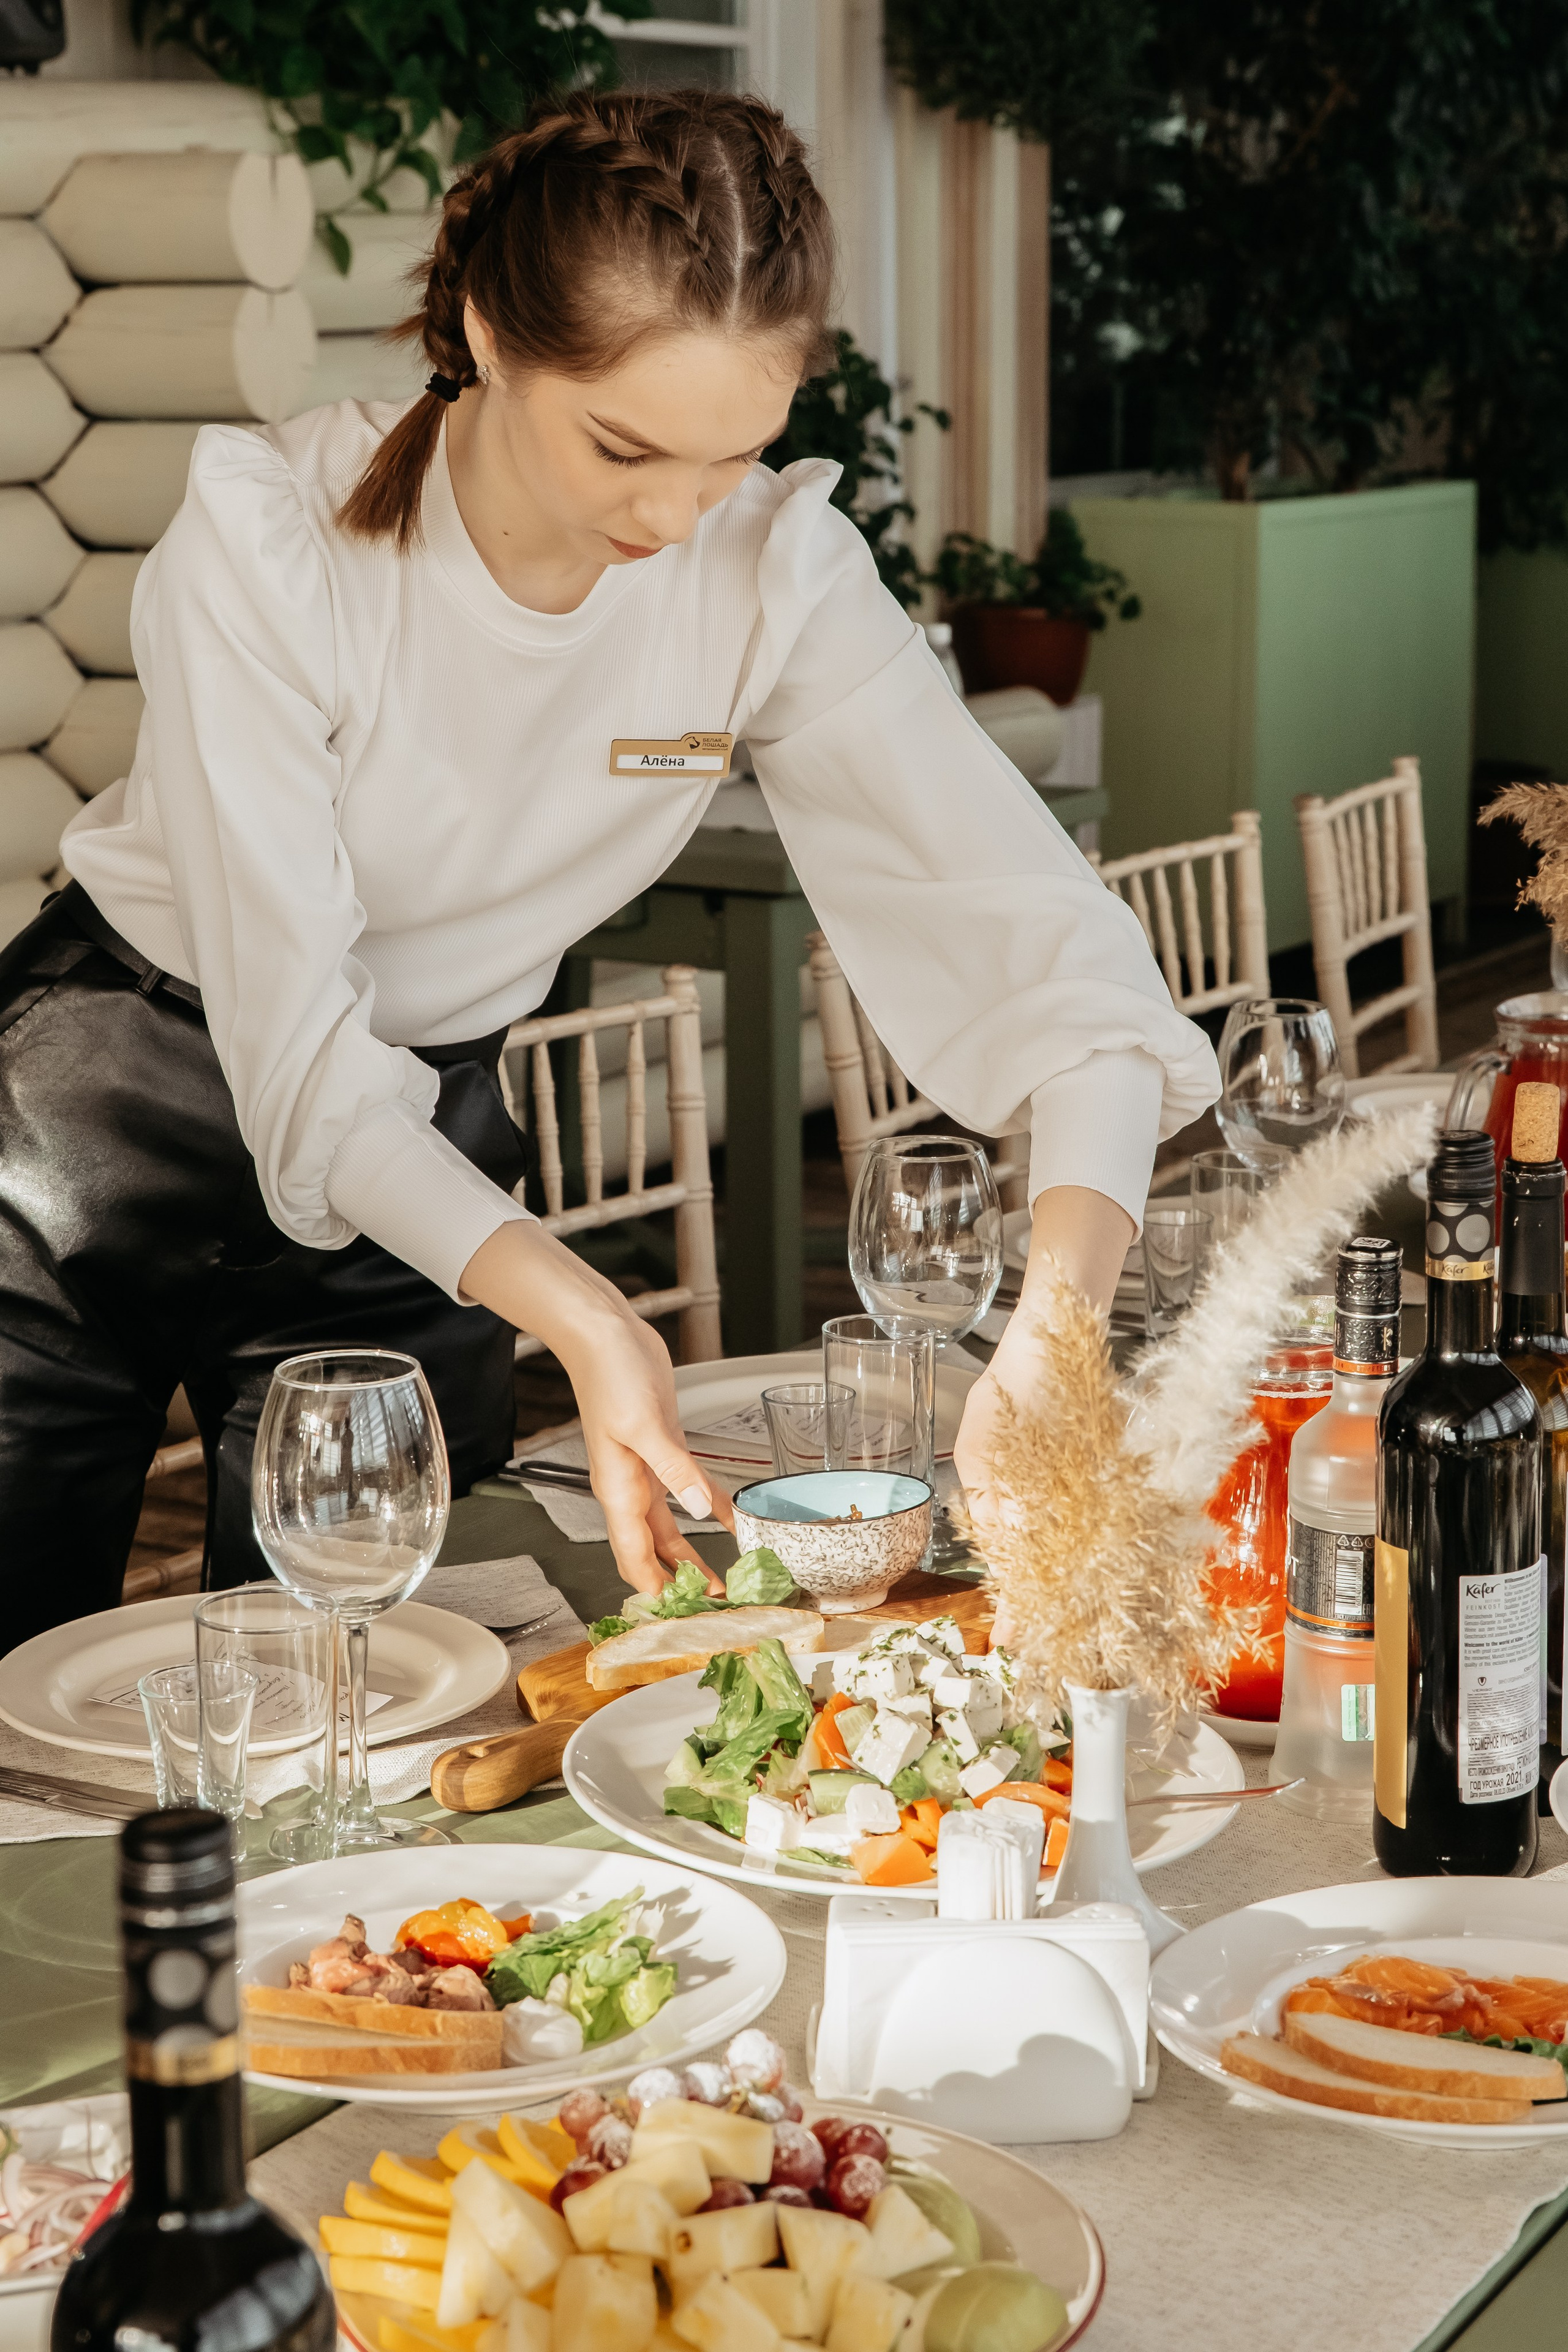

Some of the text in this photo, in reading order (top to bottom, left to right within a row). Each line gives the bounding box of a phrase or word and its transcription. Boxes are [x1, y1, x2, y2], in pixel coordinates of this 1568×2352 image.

[640, 754, 685, 766] Алёна
[1470, 1781, 1481, 1791] ГОД
[1482, 1777, 1504, 1789] УРОЖАЯ
